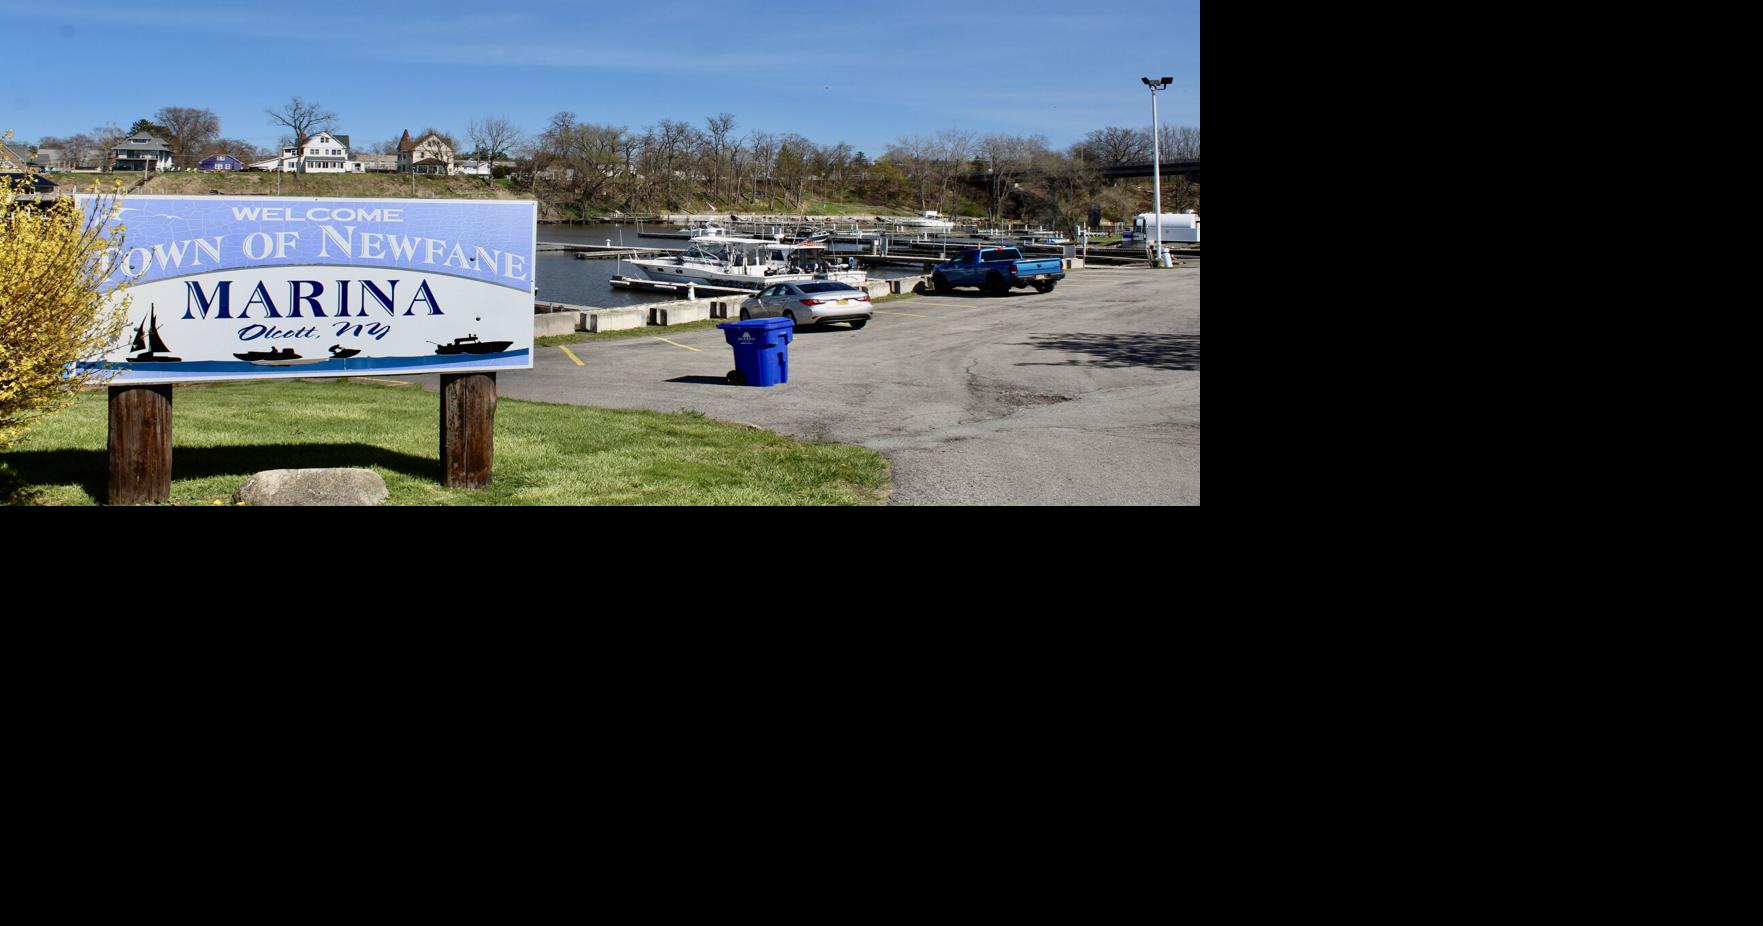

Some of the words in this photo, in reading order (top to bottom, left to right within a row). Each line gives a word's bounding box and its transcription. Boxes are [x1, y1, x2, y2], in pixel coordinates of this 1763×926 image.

[231, 207, 403, 222] WELCOME
[242, 231, 300, 260] OF
[317, 225, 526, 280] NEWFANE
[181, 279, 445, 320] MARINA
[237, 323, 321, 342] Olcott,
[332, 321, 392, 341] NY
